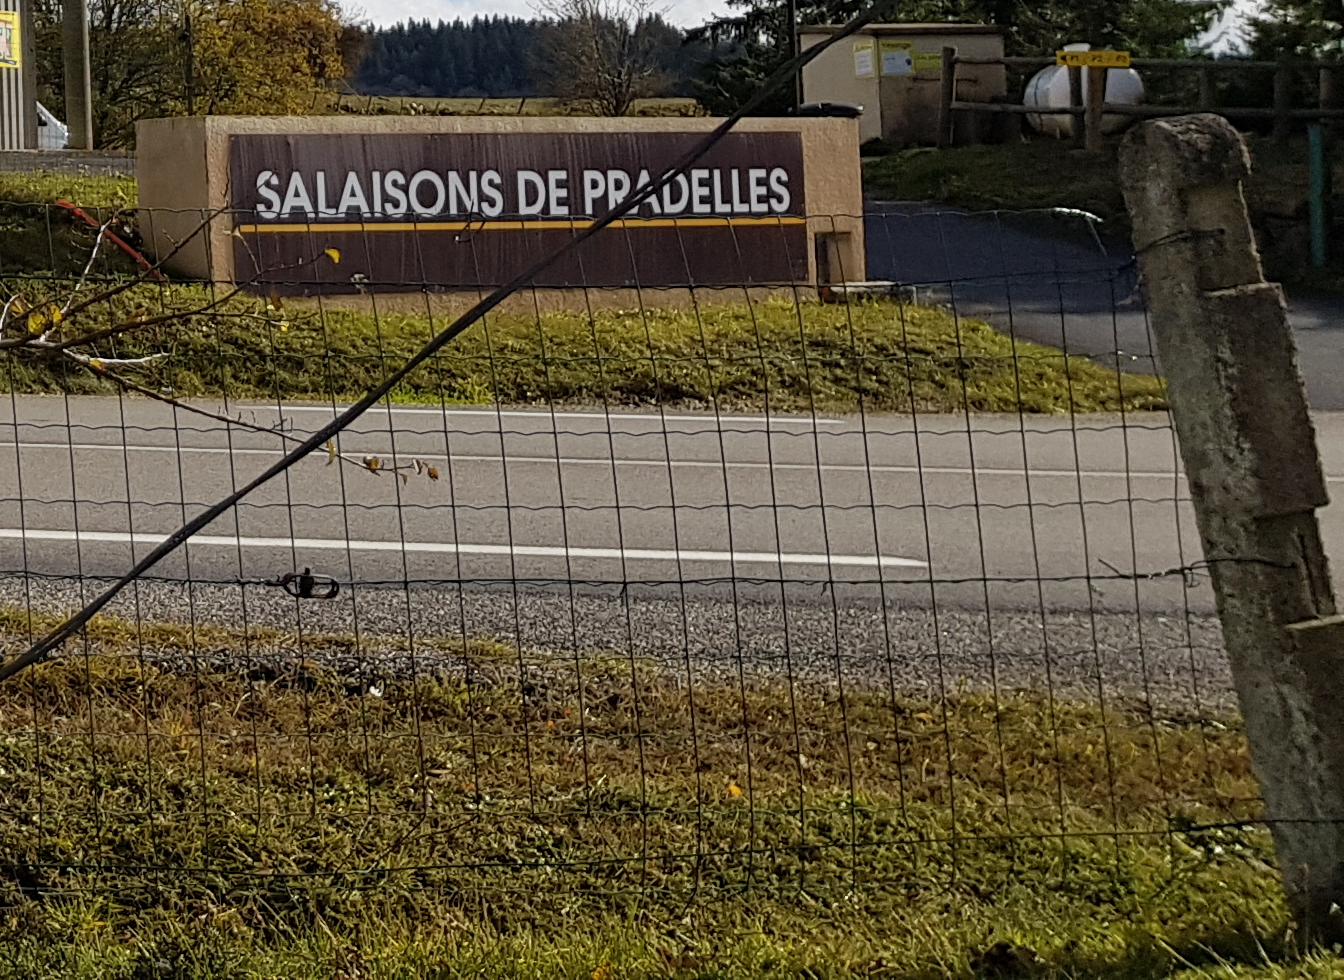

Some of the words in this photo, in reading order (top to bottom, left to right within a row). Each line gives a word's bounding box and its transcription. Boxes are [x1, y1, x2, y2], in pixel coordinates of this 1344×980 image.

[255, 170, 504, 220] SALAISONS
[516, 169, 570, 216] DE
[583, 167, 791, 216] PRADELLES
